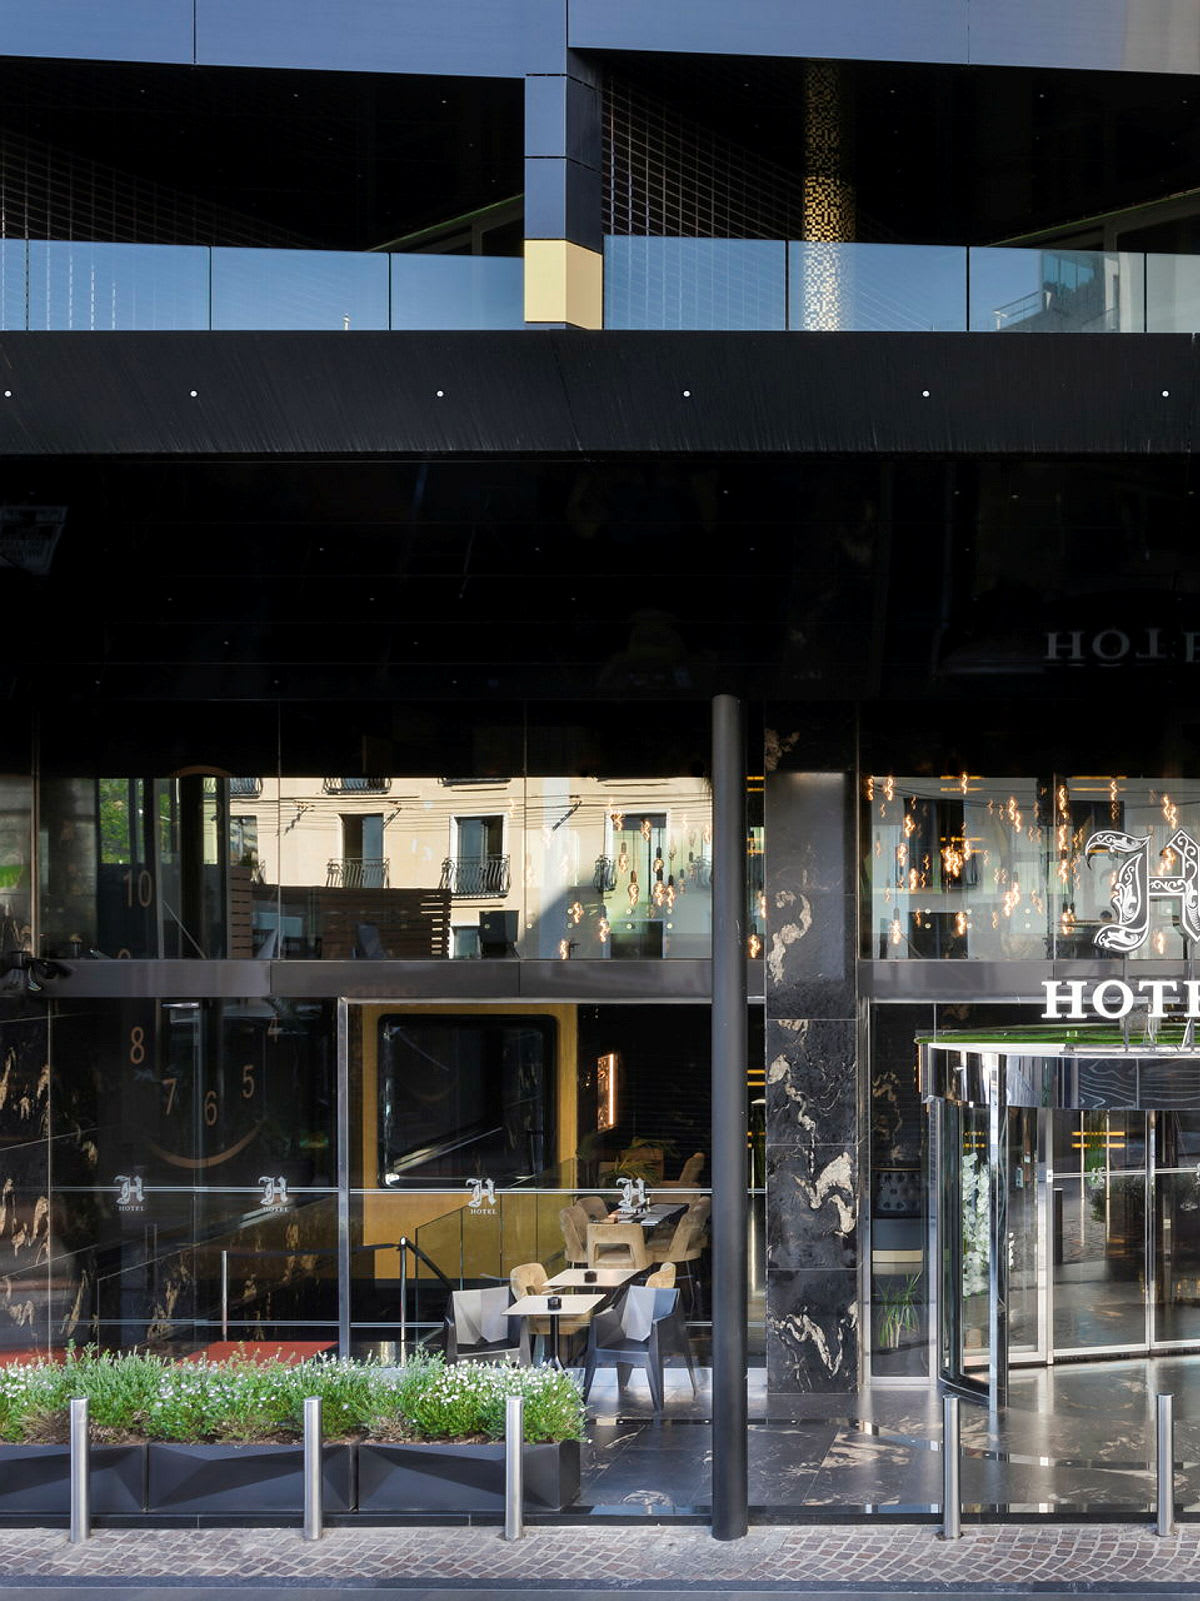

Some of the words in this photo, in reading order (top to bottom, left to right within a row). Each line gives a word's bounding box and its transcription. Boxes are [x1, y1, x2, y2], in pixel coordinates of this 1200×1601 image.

[129, 1026, 146, 1065] 8
[162, 1077, 177, 1116] 7
[241, 1064, 256, 1099] 5
[203, 1089, 218, 1127] 6
